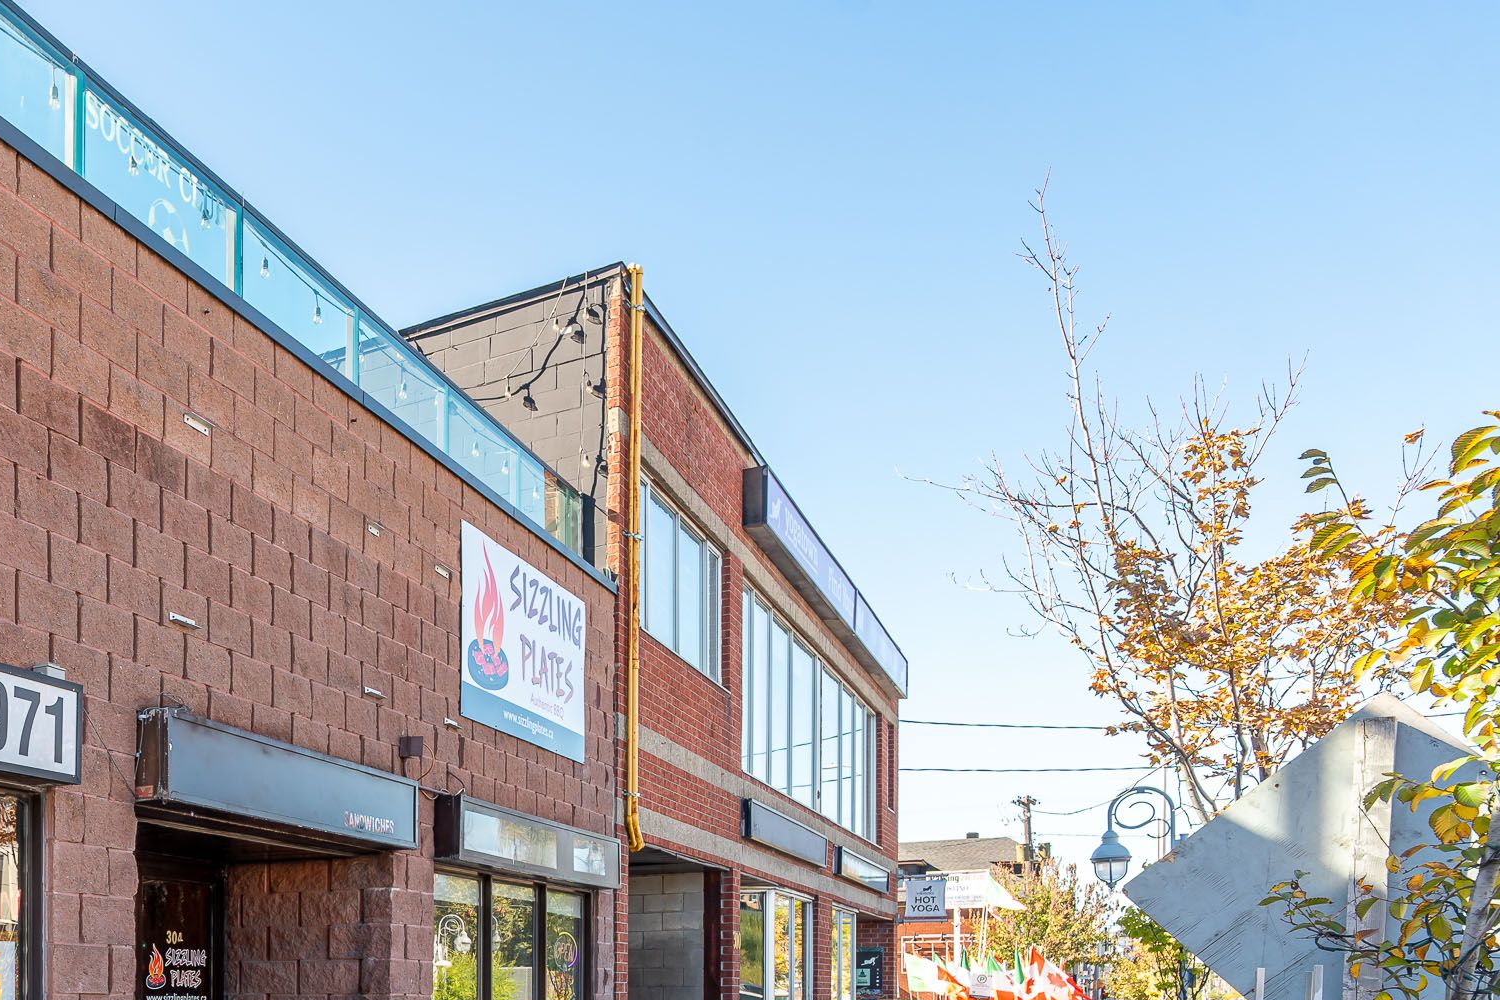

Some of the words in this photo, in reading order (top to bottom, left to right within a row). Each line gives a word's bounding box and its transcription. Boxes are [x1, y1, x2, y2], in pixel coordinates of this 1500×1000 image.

[85, 89, 171, 189] SOCCER
[509, 564, 583, 650] SIZZLING
[520, 634, 574, 705] PLATES
[911, 904, 940, 912] YOGA
[914, 896, 937, 904] HOT
[164, 947, 207, 967] SIZZLING
[170, 969, 202, 988] PLATES
